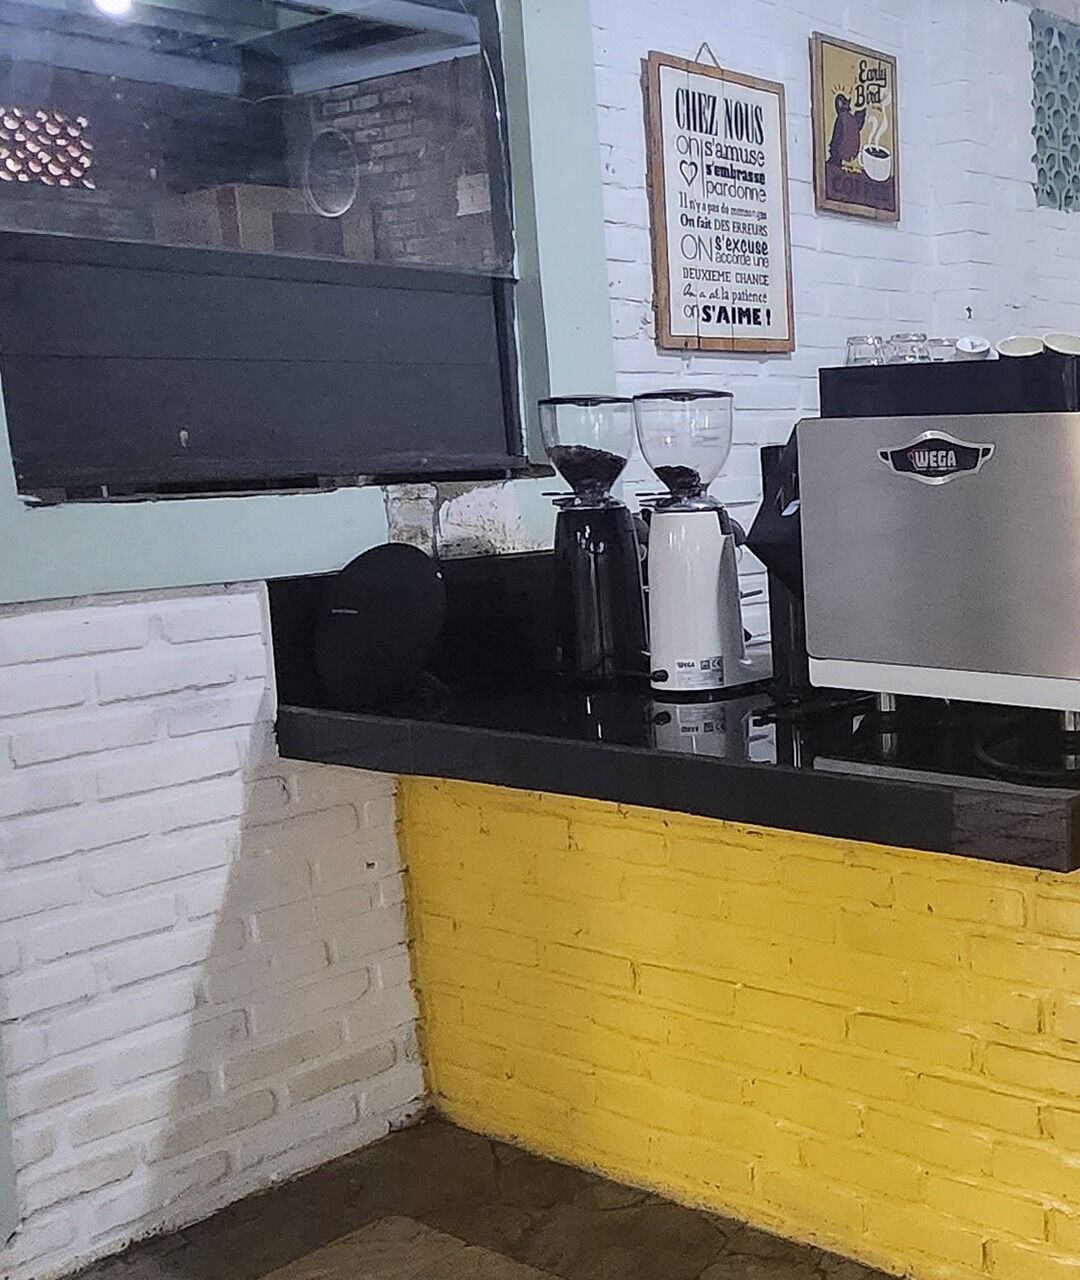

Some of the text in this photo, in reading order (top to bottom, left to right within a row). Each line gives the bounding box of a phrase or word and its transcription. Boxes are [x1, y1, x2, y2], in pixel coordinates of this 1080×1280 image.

[858, 59, 887, 88] Early
[854, 84, 882, 108] Bird
[675, 87, 765, 146] CHEZ NOUS
[676, 135, 765, 167] on s'amuse
[705, 161, 766, 185] s'embrasse
[706, 179, 767, 203] pardonne
[707, 203, 720, 215] pas
[680, 213, 768, 237] On fait DES ERREURS
[681, 233, 769, 262] ON s'excuse
[715, 250, 769, 268] accorde une
[682, 267, 770, 286] DEUXIEME CHANCE
[731, 289, 768, 305] patience
[683, 304, 771, 326] on S'AIME !
[914, 450, 957, 468] WEGA
